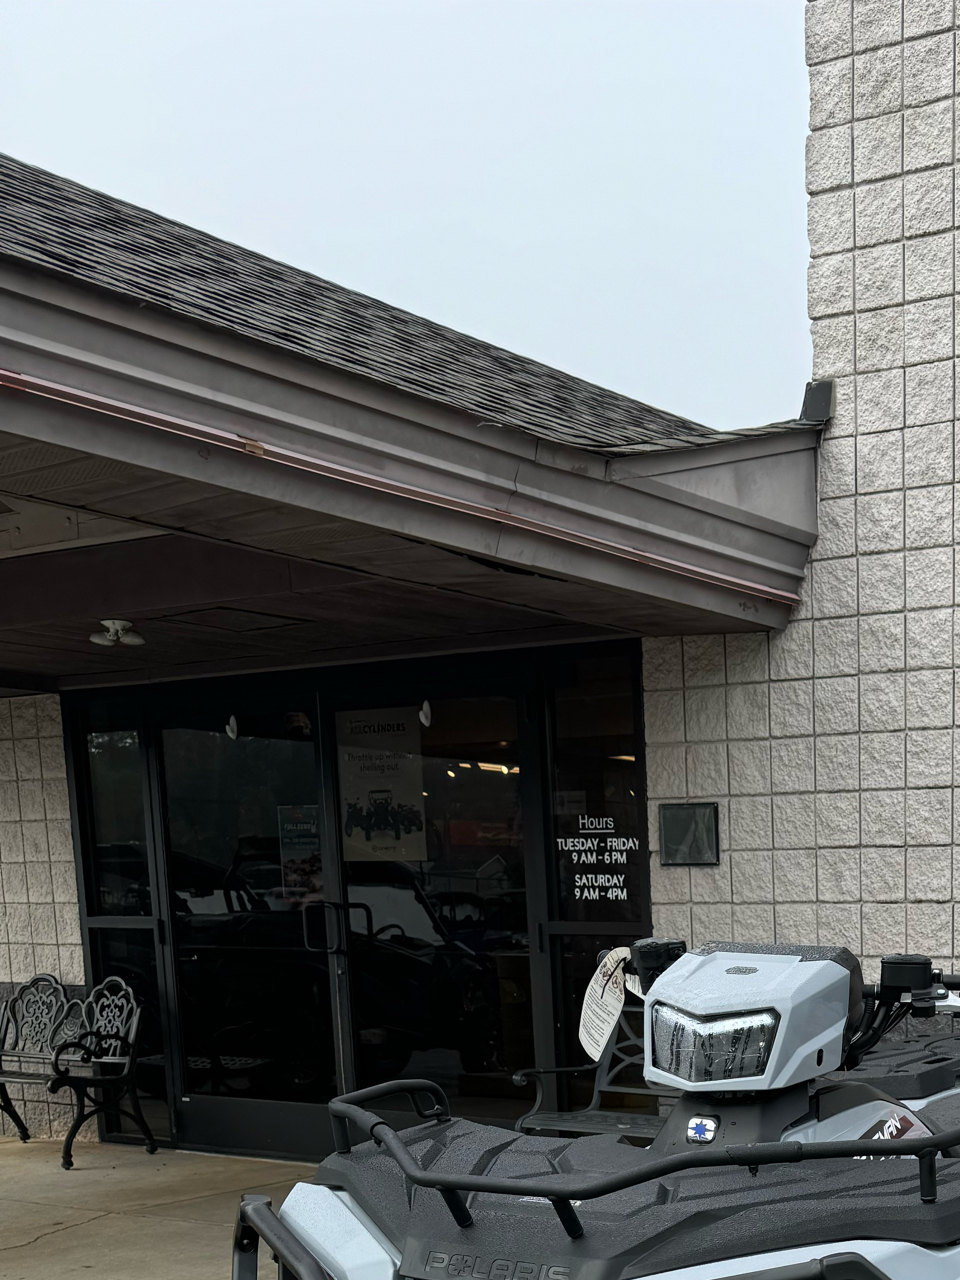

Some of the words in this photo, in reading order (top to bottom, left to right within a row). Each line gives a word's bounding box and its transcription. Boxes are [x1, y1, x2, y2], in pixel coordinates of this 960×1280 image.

[360, 762, 386, 774] shelling
[578, 814, 615, 829] Hours
[556, 838, 599, 851] TUESDAY
[606, 838, 640, 851] FRIDAY
[571, 852, 578, 864] 9
[579, 852, 597, 864] AM
[604, 852, 611, 864] 6
[612, 852, 627, 864] PM
[574, 874, 625, 887] SATURDAY
[574, 887, 581, 900] 9
[582, 887, 599, 900] AM
[606, 887, 628, 901] 4PM
